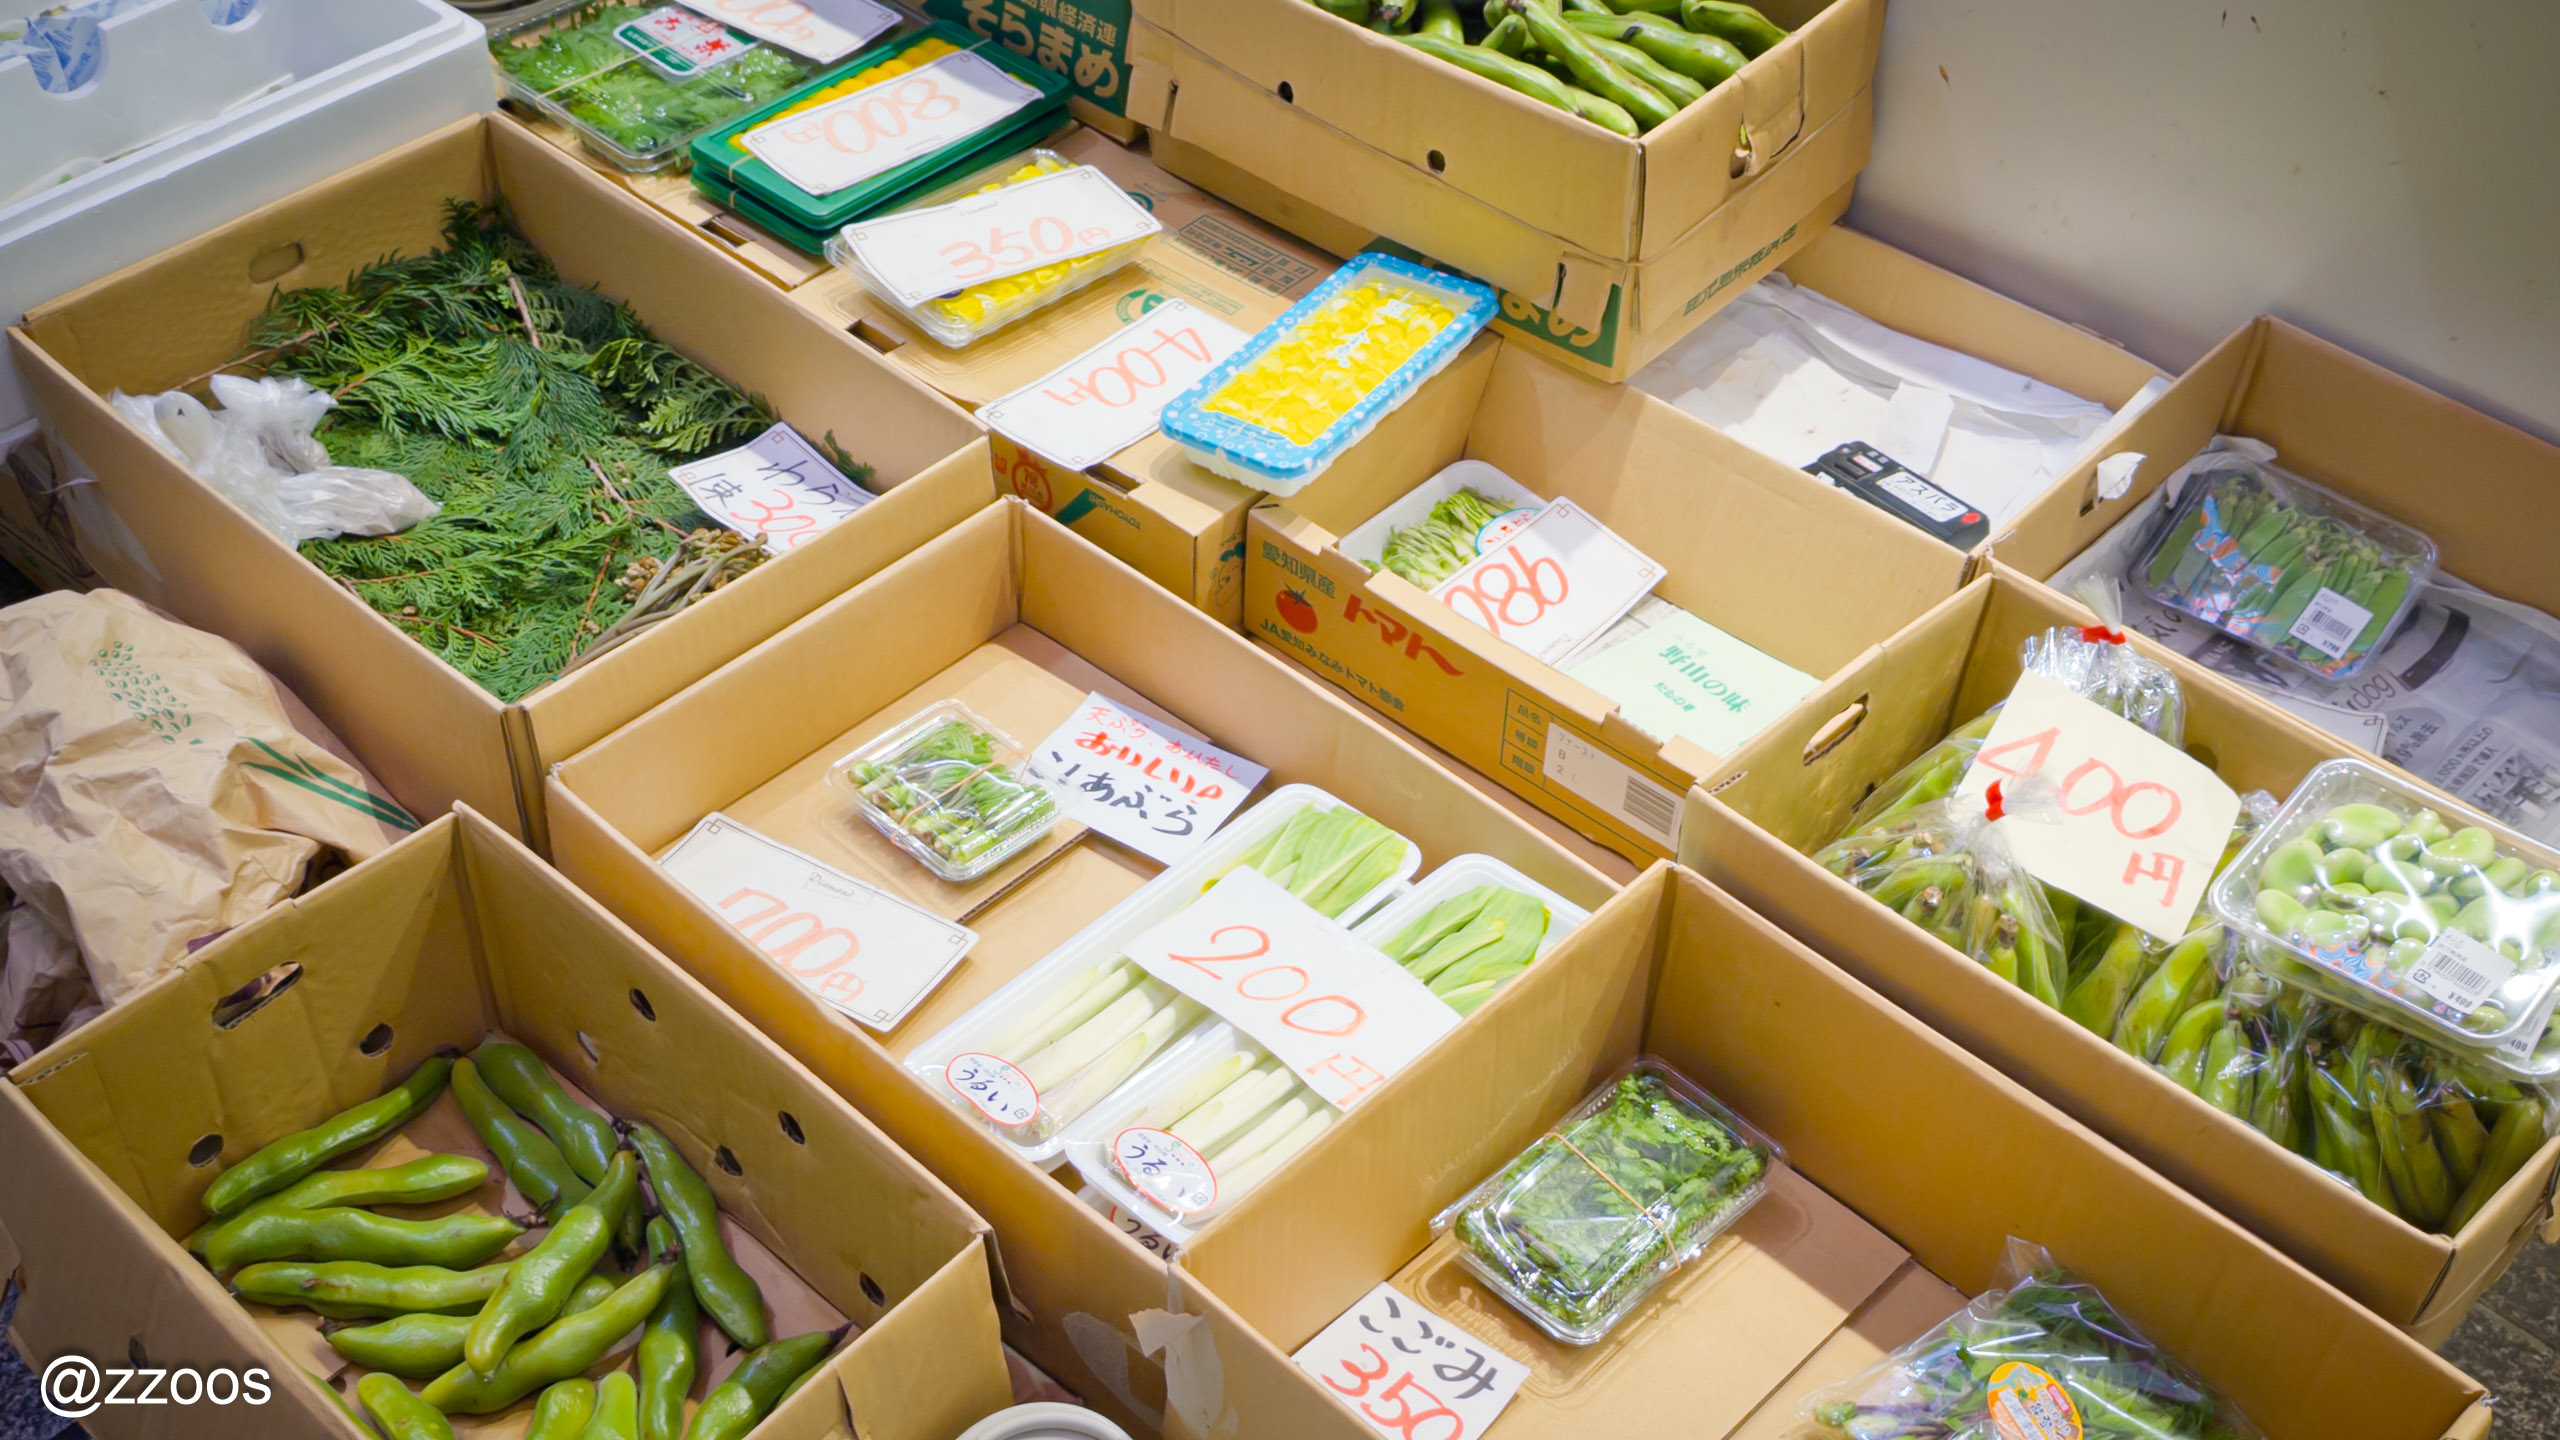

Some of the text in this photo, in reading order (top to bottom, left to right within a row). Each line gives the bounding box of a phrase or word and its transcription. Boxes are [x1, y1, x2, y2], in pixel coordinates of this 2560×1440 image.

[962, 0, 1120, 98] そらまめ
[939, 215, 1111, 279] 350円
[1262, 541, 1336, 599] 愛知県産
[1343, 593, 1465, 677] トマト
[1658, 644, 1751, 713] 野山の味
[2123, 851, 2186, 909] 円
[954, 1068, 1008, 1111] うるい
[1359, 1296, 1499, 1399] こごみ
[1320, 1342, 1464, 1440] 350
